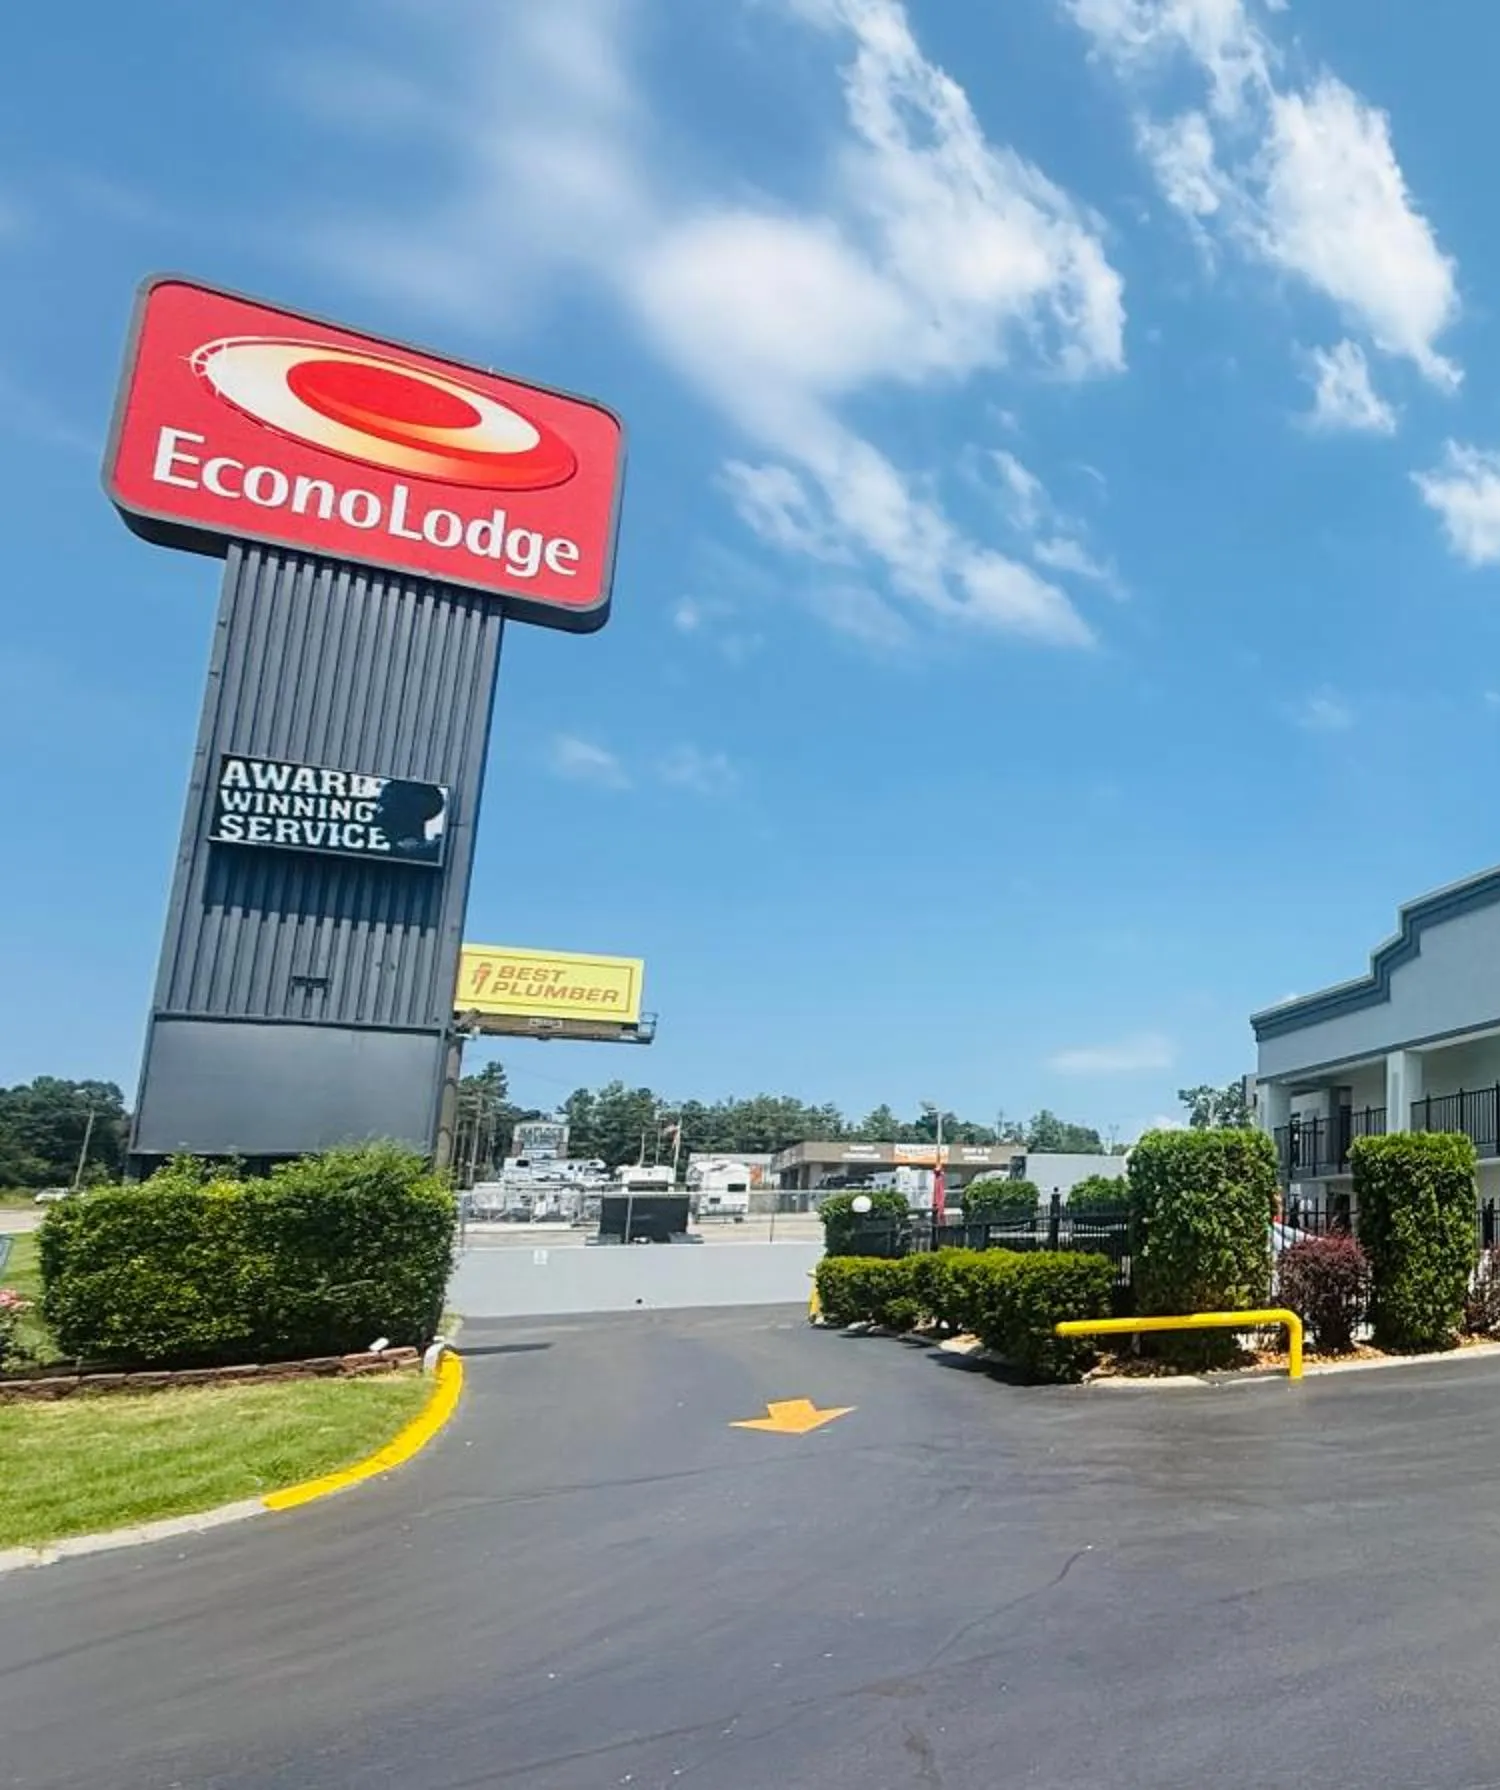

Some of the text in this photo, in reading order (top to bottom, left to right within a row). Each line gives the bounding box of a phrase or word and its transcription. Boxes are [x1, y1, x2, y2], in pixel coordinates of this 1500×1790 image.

[153, 426, 579, 576] EconoLodge
[220, 789, 377, 822] WINNING
[219, 814, 391, 850] SERVICE
[498, 965, 566, 983] BEST
[491, 981, 620, 1003] PLUMBER
